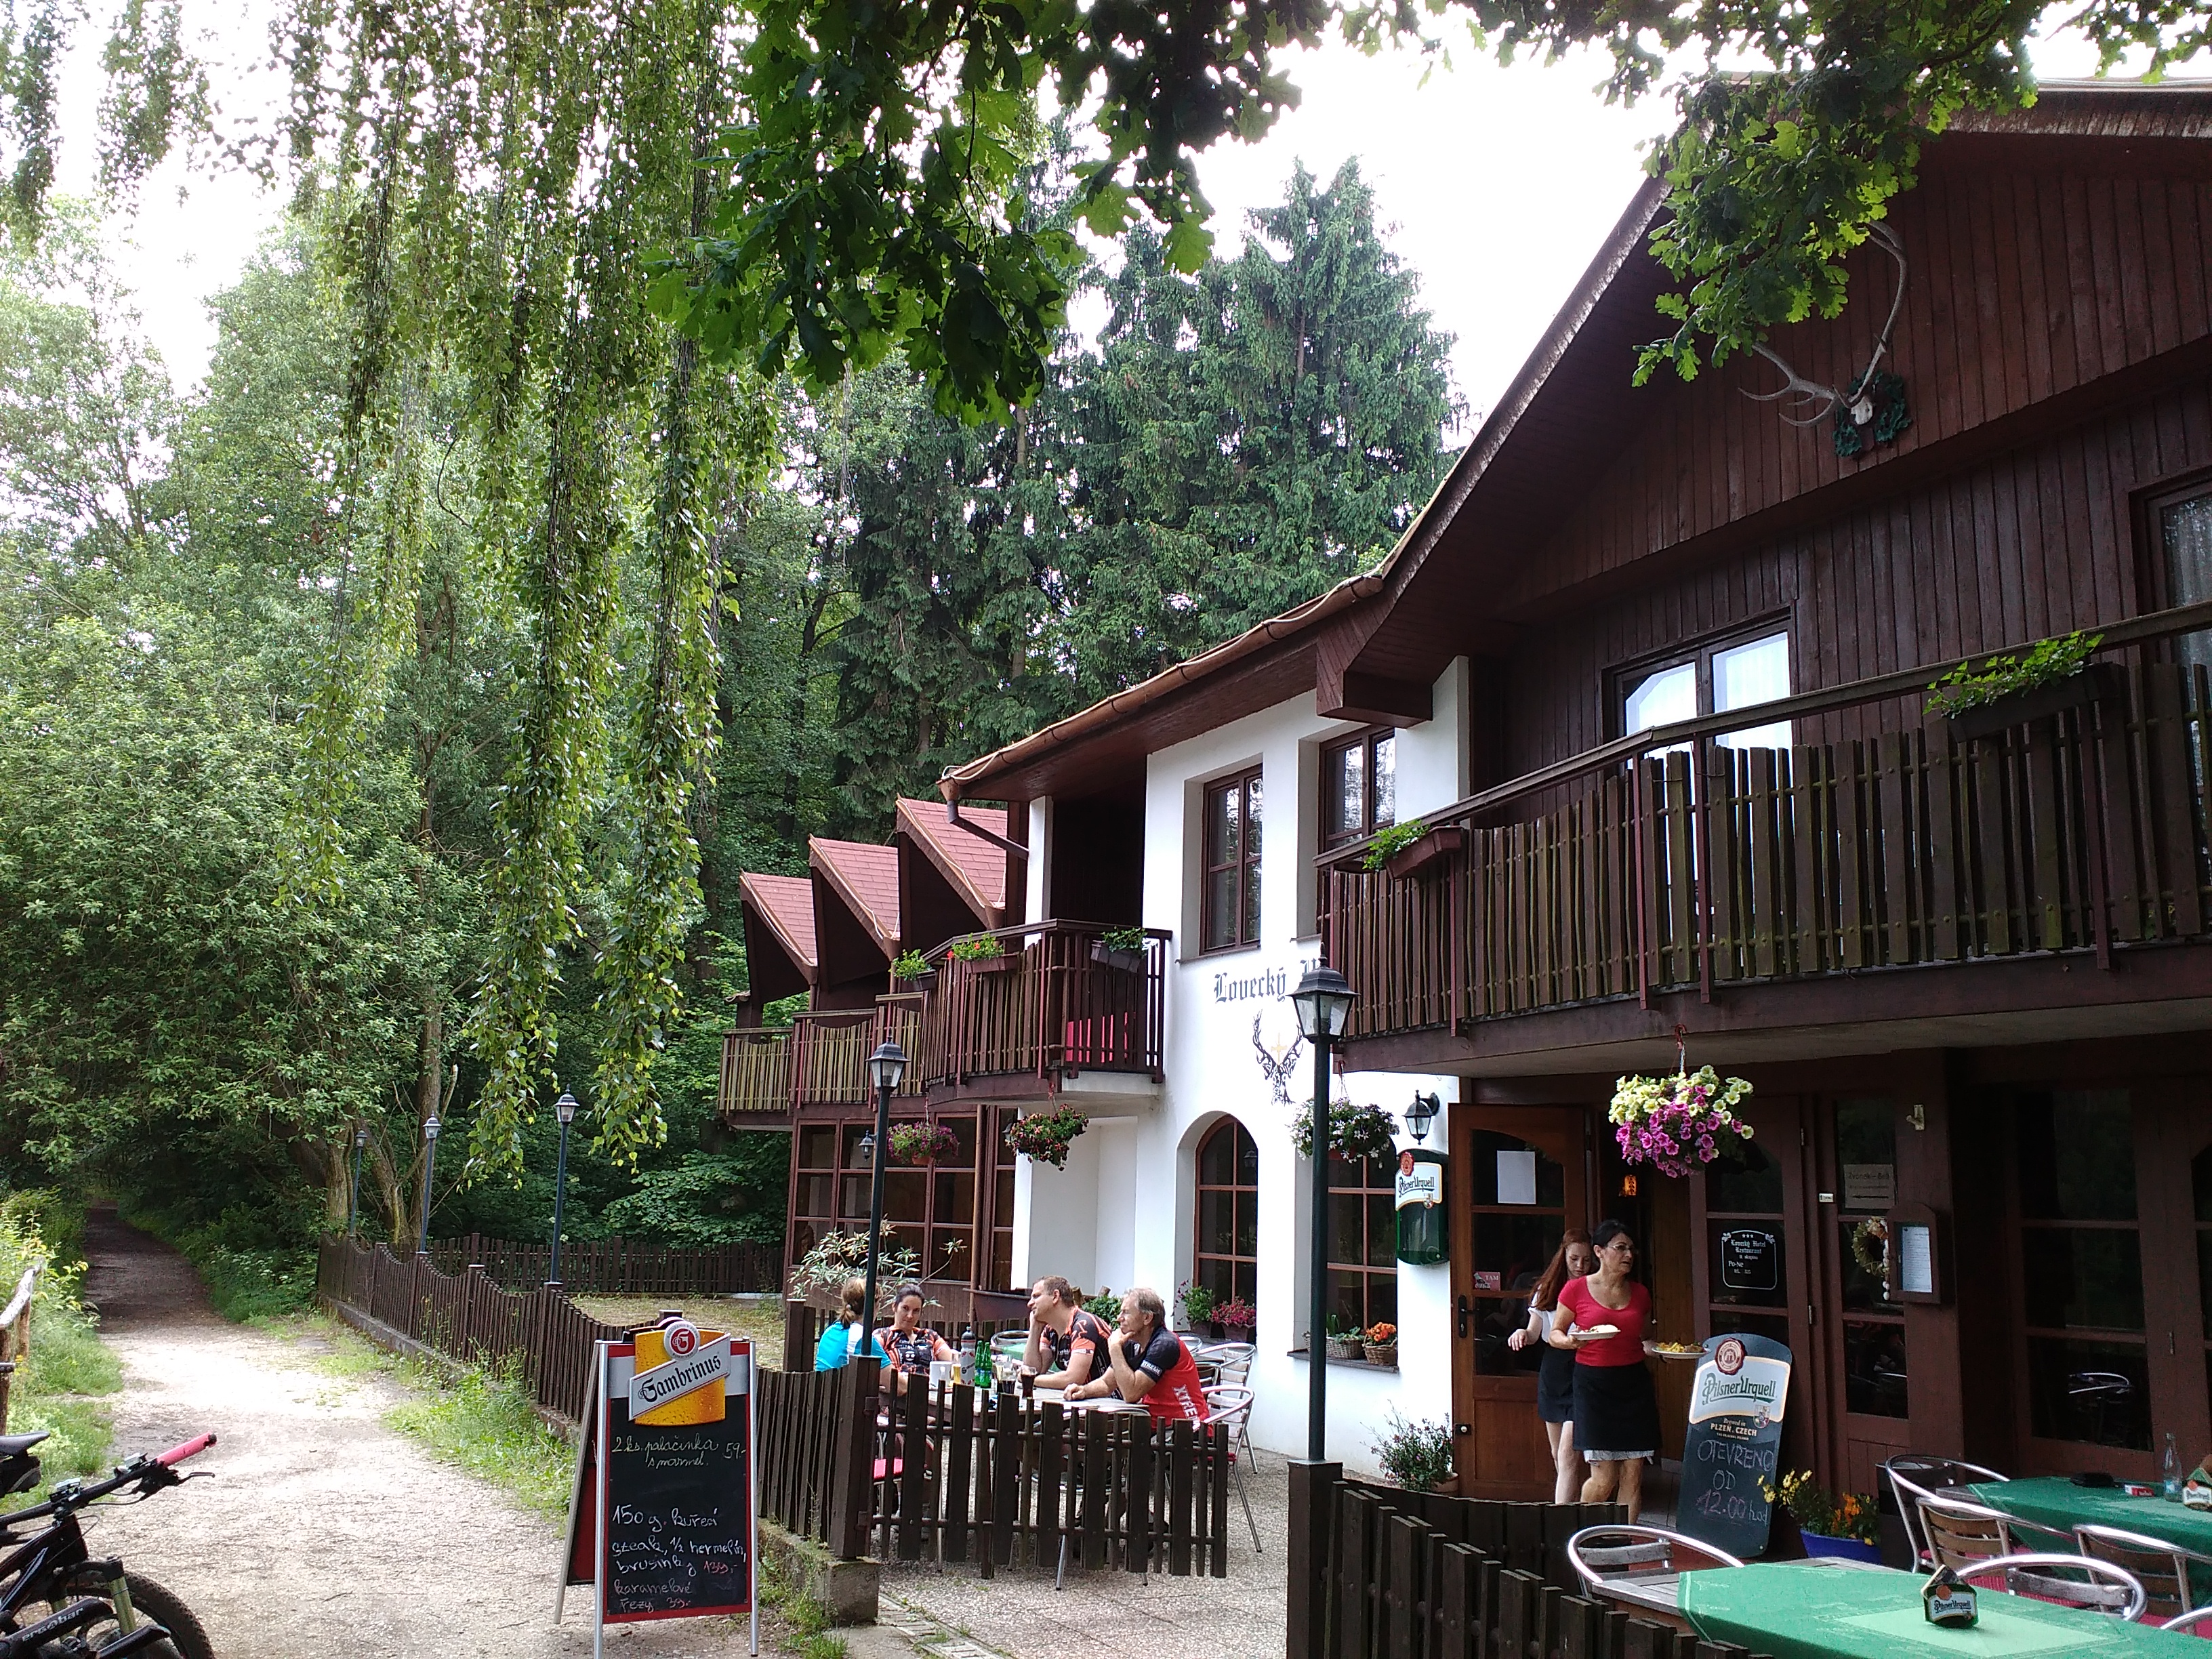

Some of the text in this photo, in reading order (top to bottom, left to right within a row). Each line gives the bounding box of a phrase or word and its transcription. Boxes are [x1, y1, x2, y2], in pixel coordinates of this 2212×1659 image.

[638, 1355, 721, 1403] Gambrinus
[1736, 1427, 1757, 1437] CZECH
[1713, 1469, 1736, 1490] OD
[612, 1504, 644, 1524] 150
